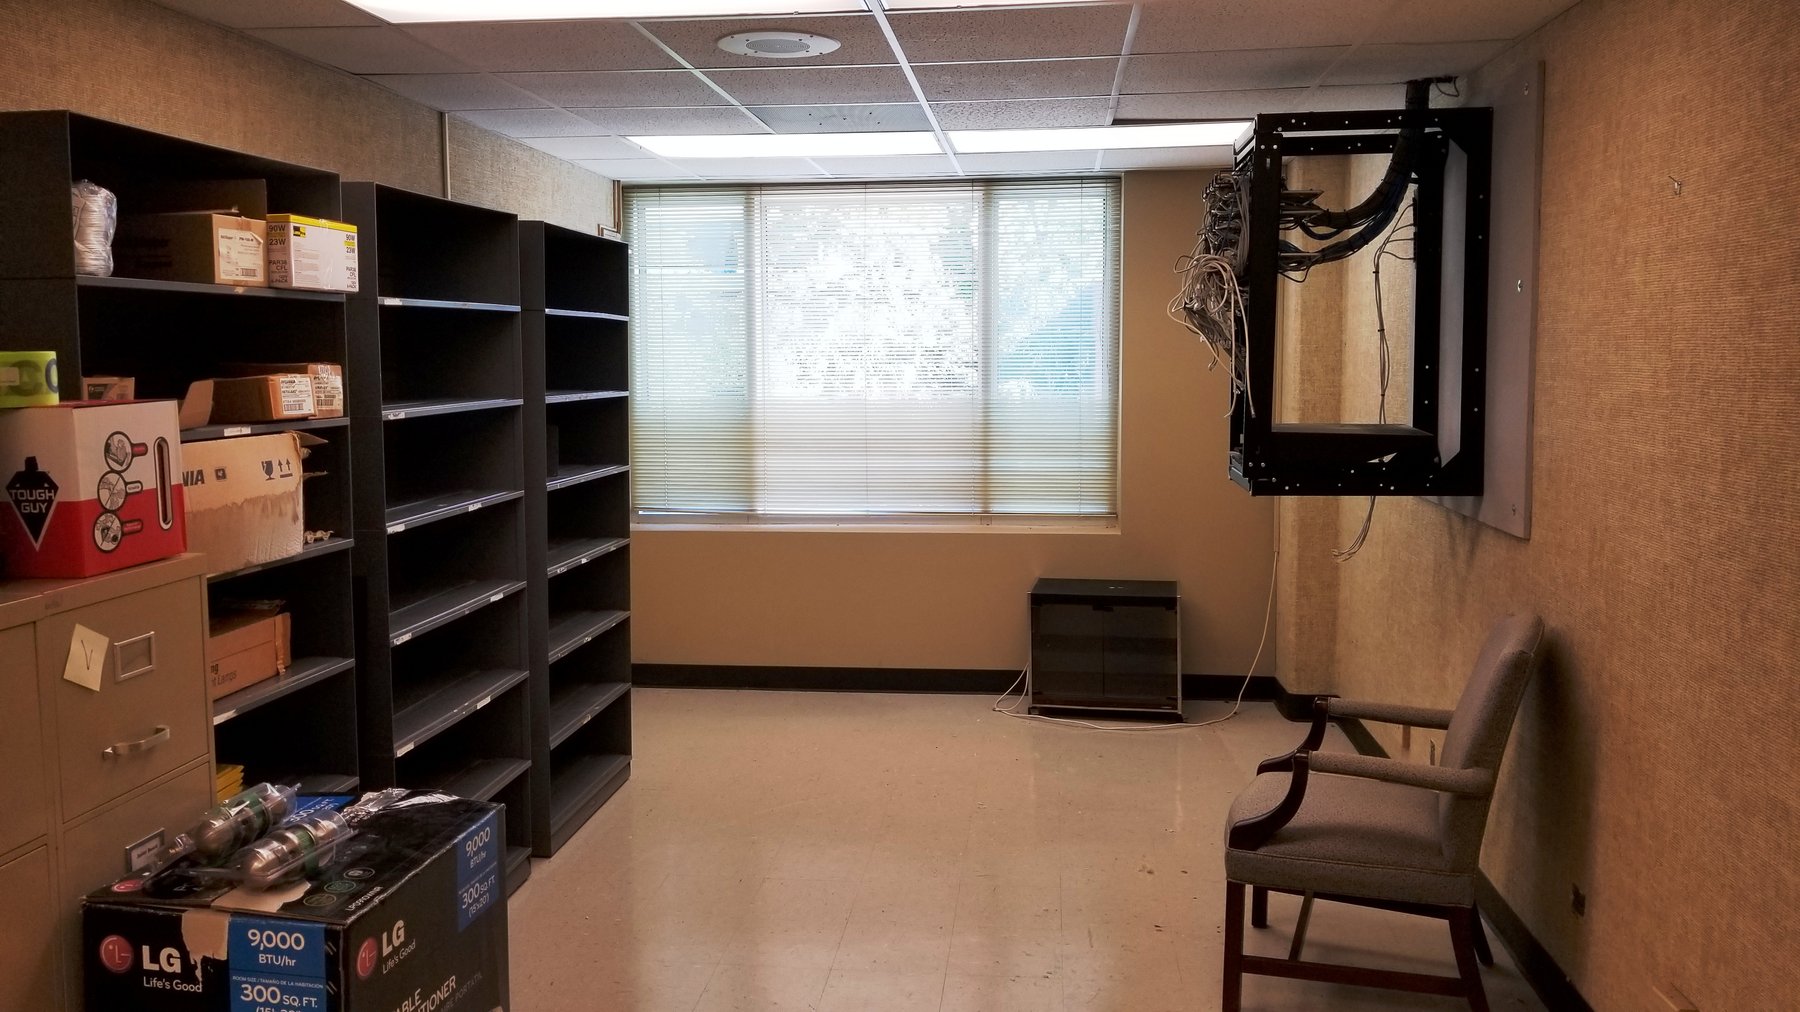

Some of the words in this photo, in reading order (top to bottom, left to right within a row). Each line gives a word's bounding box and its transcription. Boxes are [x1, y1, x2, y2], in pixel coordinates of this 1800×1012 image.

[268, 224, 286, 233] 90W
[345, 233, 356, 241] 90W
[268, 238, 286, 246] 23W
[9, 489, 55, 501] TOUGH
[21, 502, 48, 514] GUY
[465, 826, 491, 857] 9,000
[461, 882, 480, 909] 300
[247, 928, 306, 951] 9,000
[382, 919, 405, 958] LG
[142, 944, 182, 974] LG
[258, 953, 297, 967] BTU/hr
[382, 955, 399, 975] Life's
[399, 938, 416, 960] Good
[142, 976, 171, 990] Life's
[172, 979, 203, 993] Good
[240, 983, 281, 1004] 300
[282, 994, 301, 1007] SQ.
[302, 996, 318, 1008] FT.
